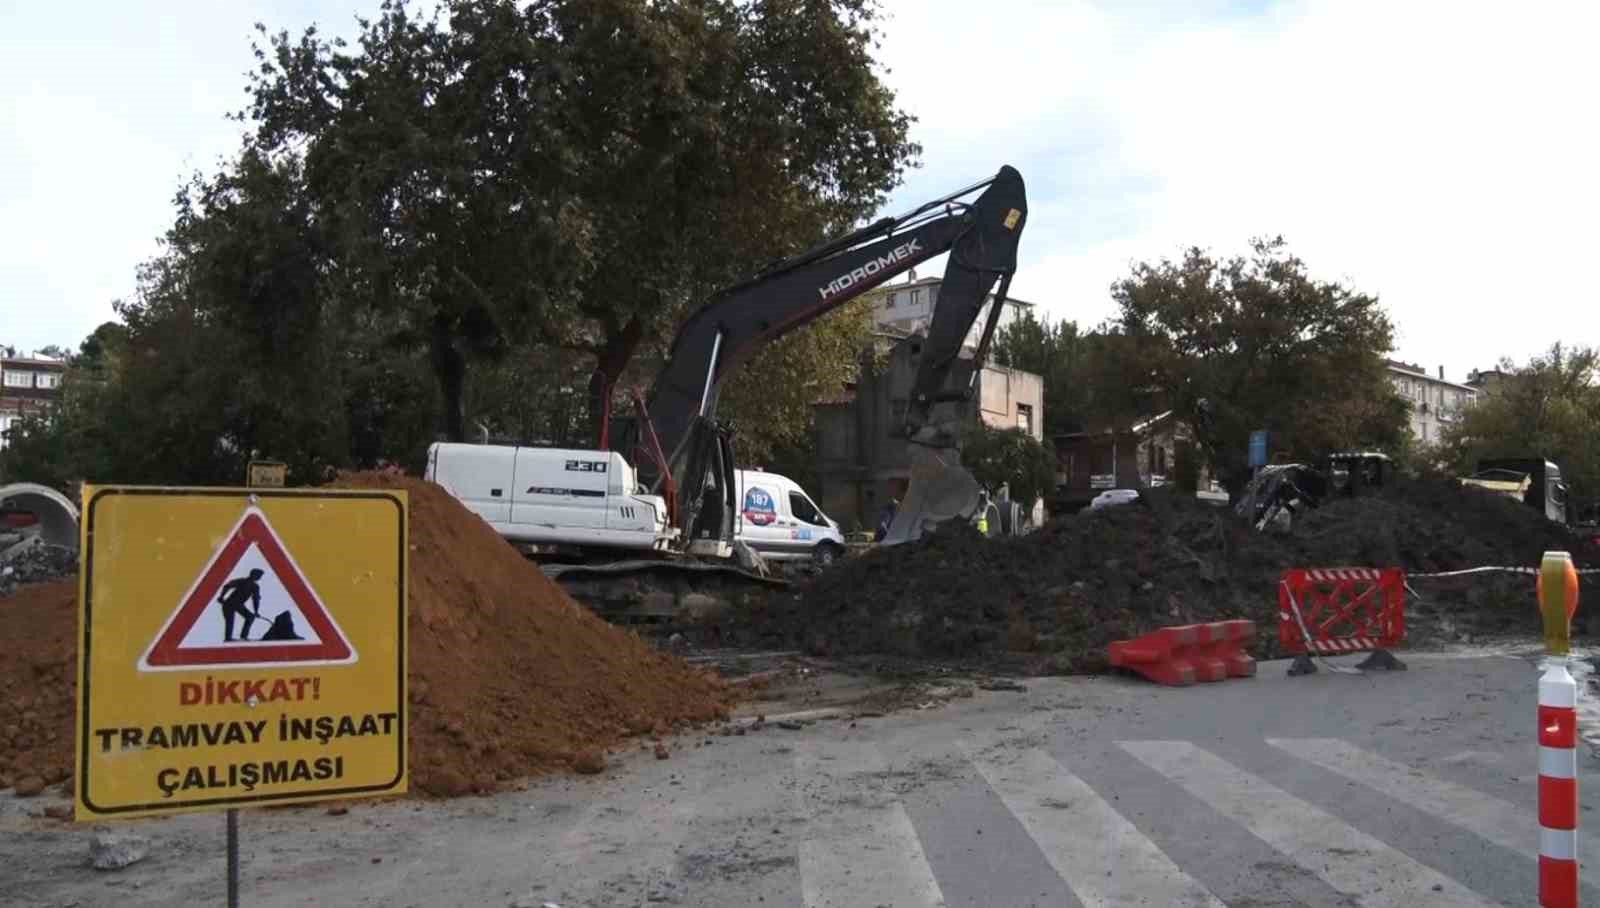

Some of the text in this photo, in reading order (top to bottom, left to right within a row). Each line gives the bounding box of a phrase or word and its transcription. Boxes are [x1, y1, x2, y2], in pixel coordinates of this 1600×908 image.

[565, 459, 607, 473] 230
[179, 677, 321, 706] DİKKAT!
[96, 713, 398, 752] TRAMVAY İNŞAAT
[157, 756, 344, 798] ÇALIŞMASI
